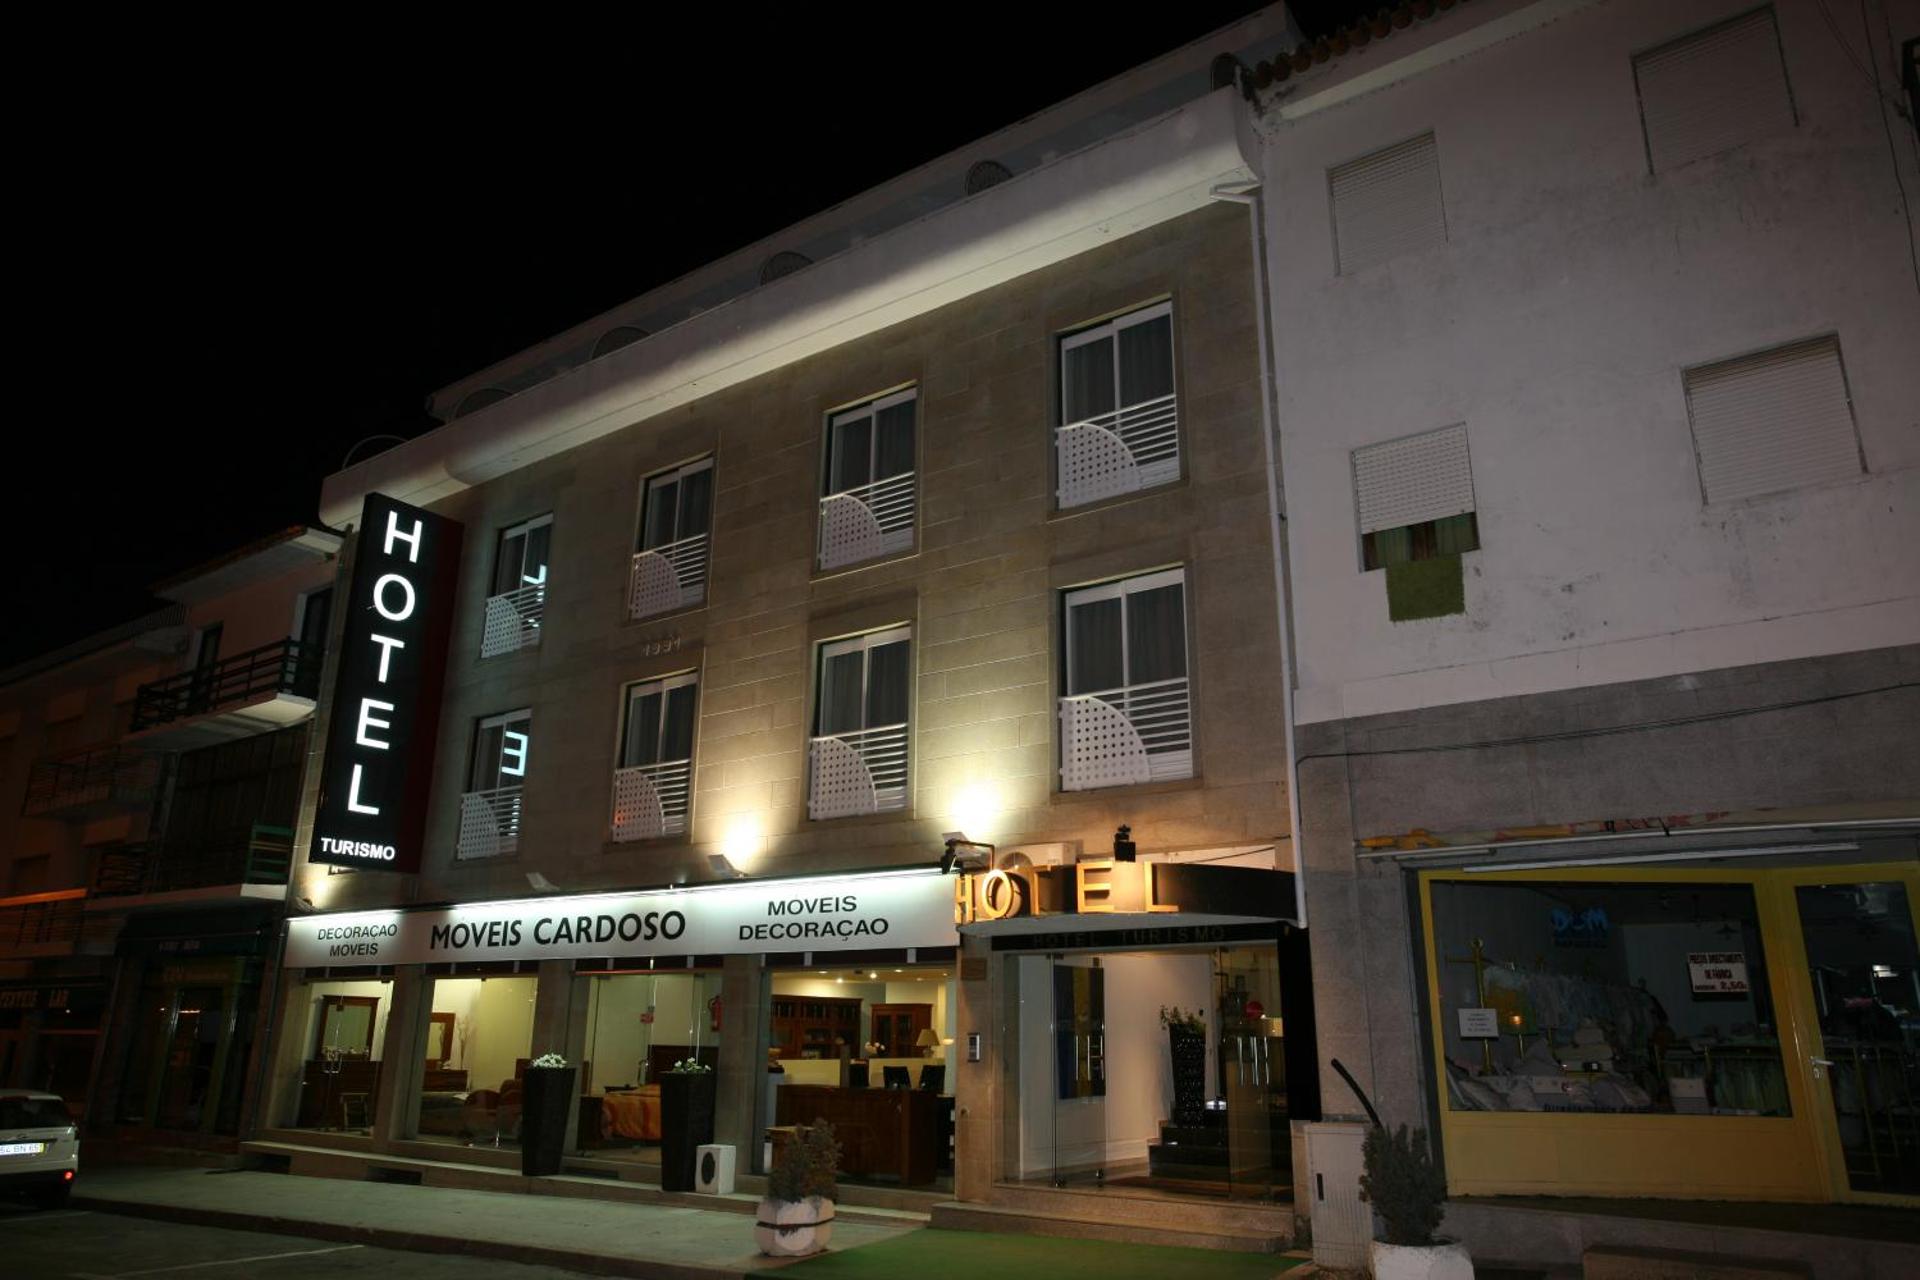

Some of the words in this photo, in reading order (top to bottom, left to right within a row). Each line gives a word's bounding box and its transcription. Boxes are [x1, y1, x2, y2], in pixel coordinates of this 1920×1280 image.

[347, 510, 423, 816] HOTEL
[320, 836, 397, 862] TURISMO
[954, 859, 1180, 925] HOTEL
[767, 895, 857, 916] MOVEIS
[430, 919, 522, 950] MOVEIS
[533, 910, 686, 945] CARDOSO
[1032, 931, 1098, 948] HOTEL
[1120, 926, 1226, 945] TURISMO
[329, 942, 379, 957] MOVEIS
